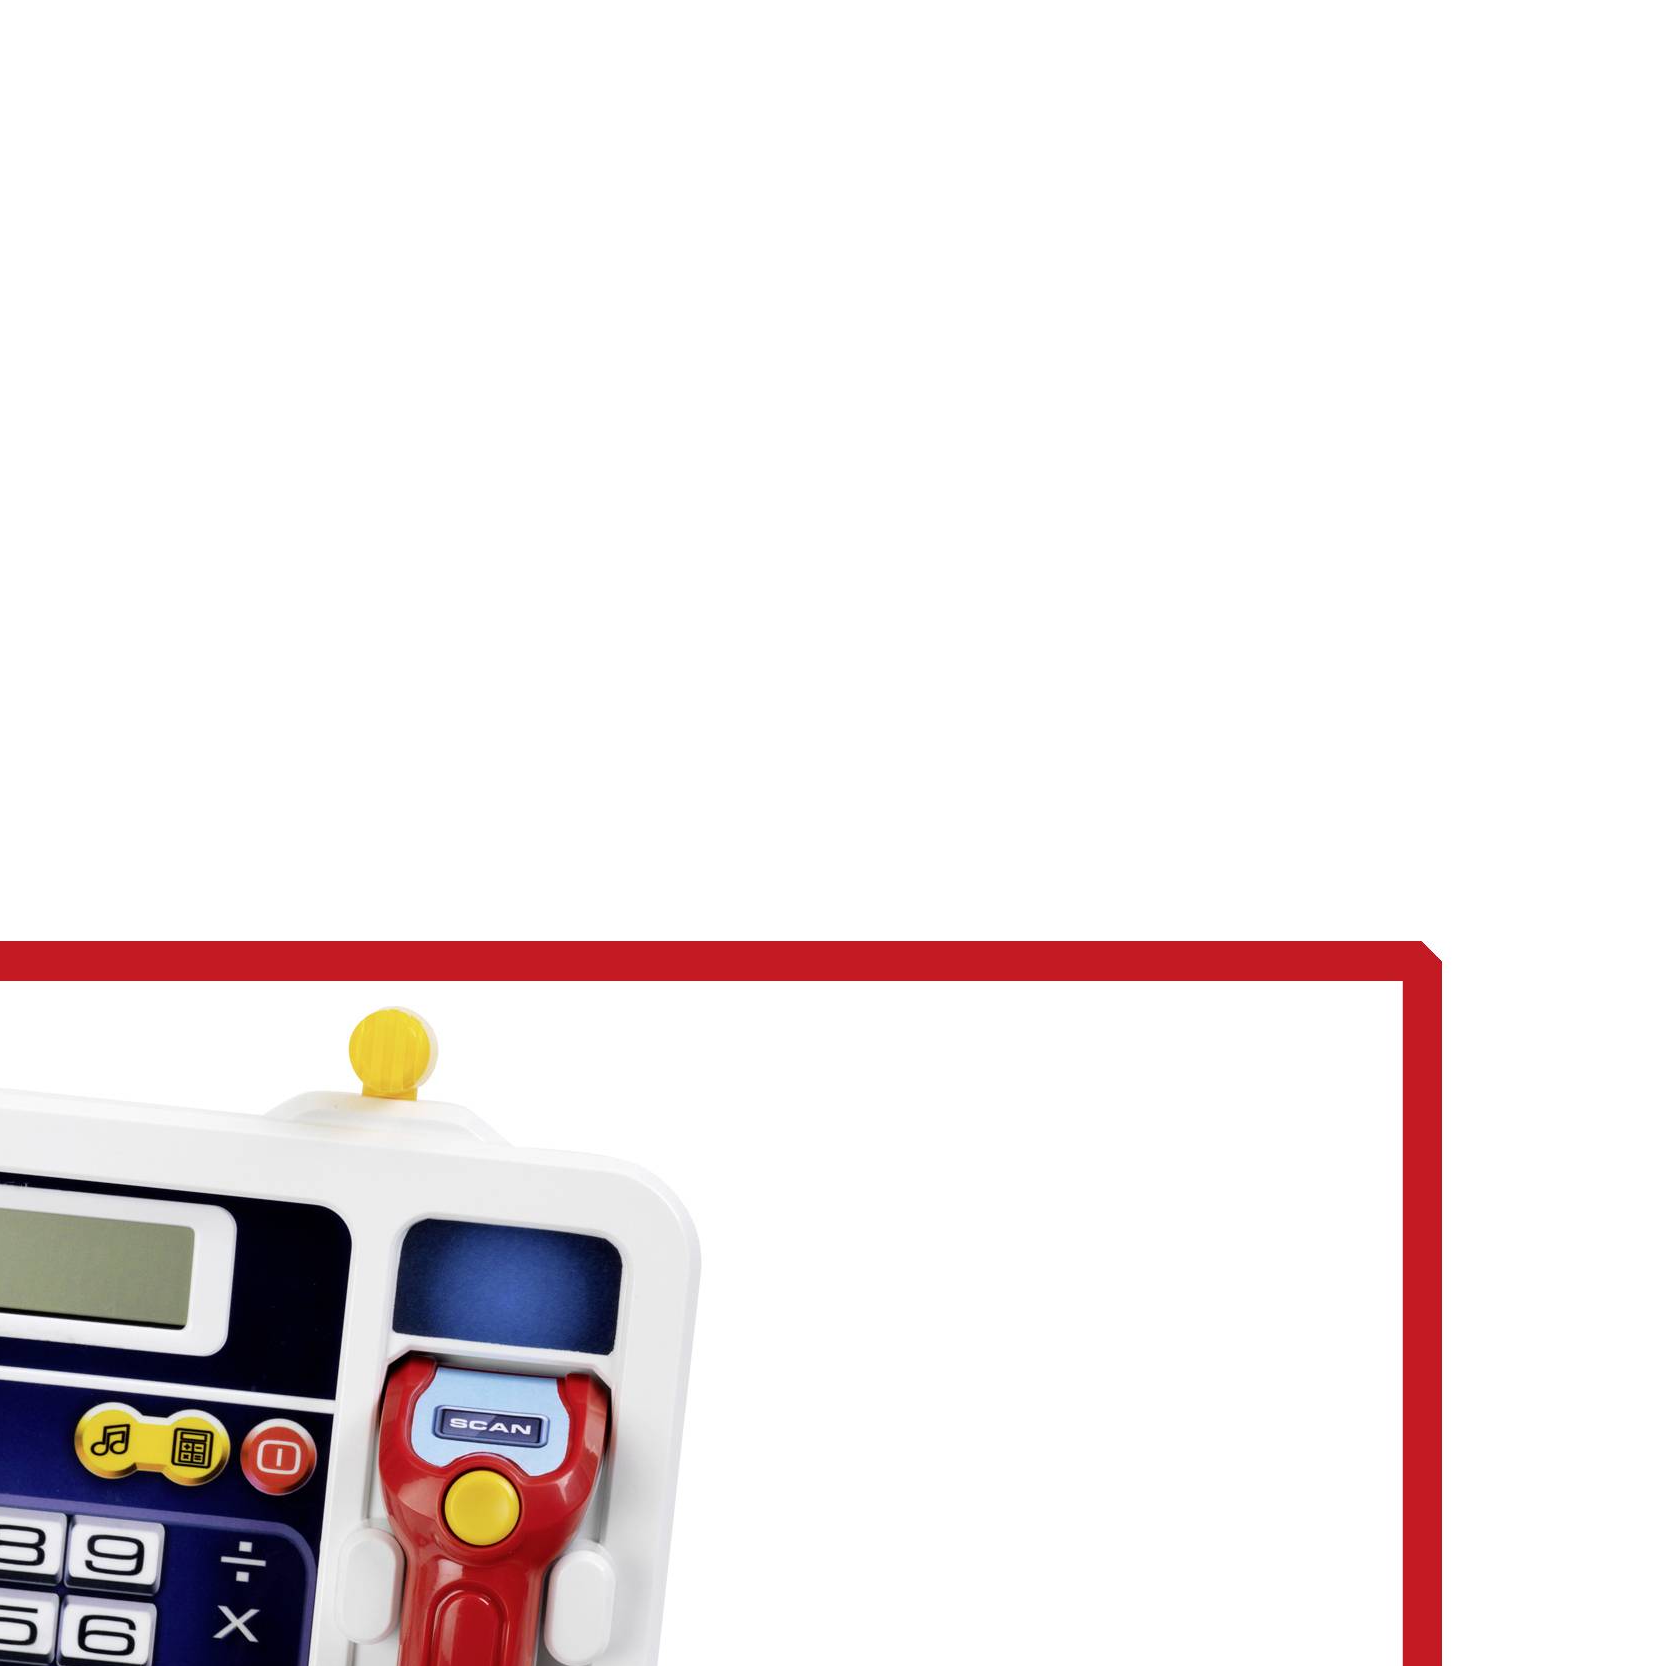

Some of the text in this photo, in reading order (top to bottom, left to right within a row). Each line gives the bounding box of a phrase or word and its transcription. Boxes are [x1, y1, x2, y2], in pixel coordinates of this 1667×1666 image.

[449, 1417, 532, 1435] SCAN
[85, 1534, 145, 1576] 9
[77, 1614, 136, 1656] 6
